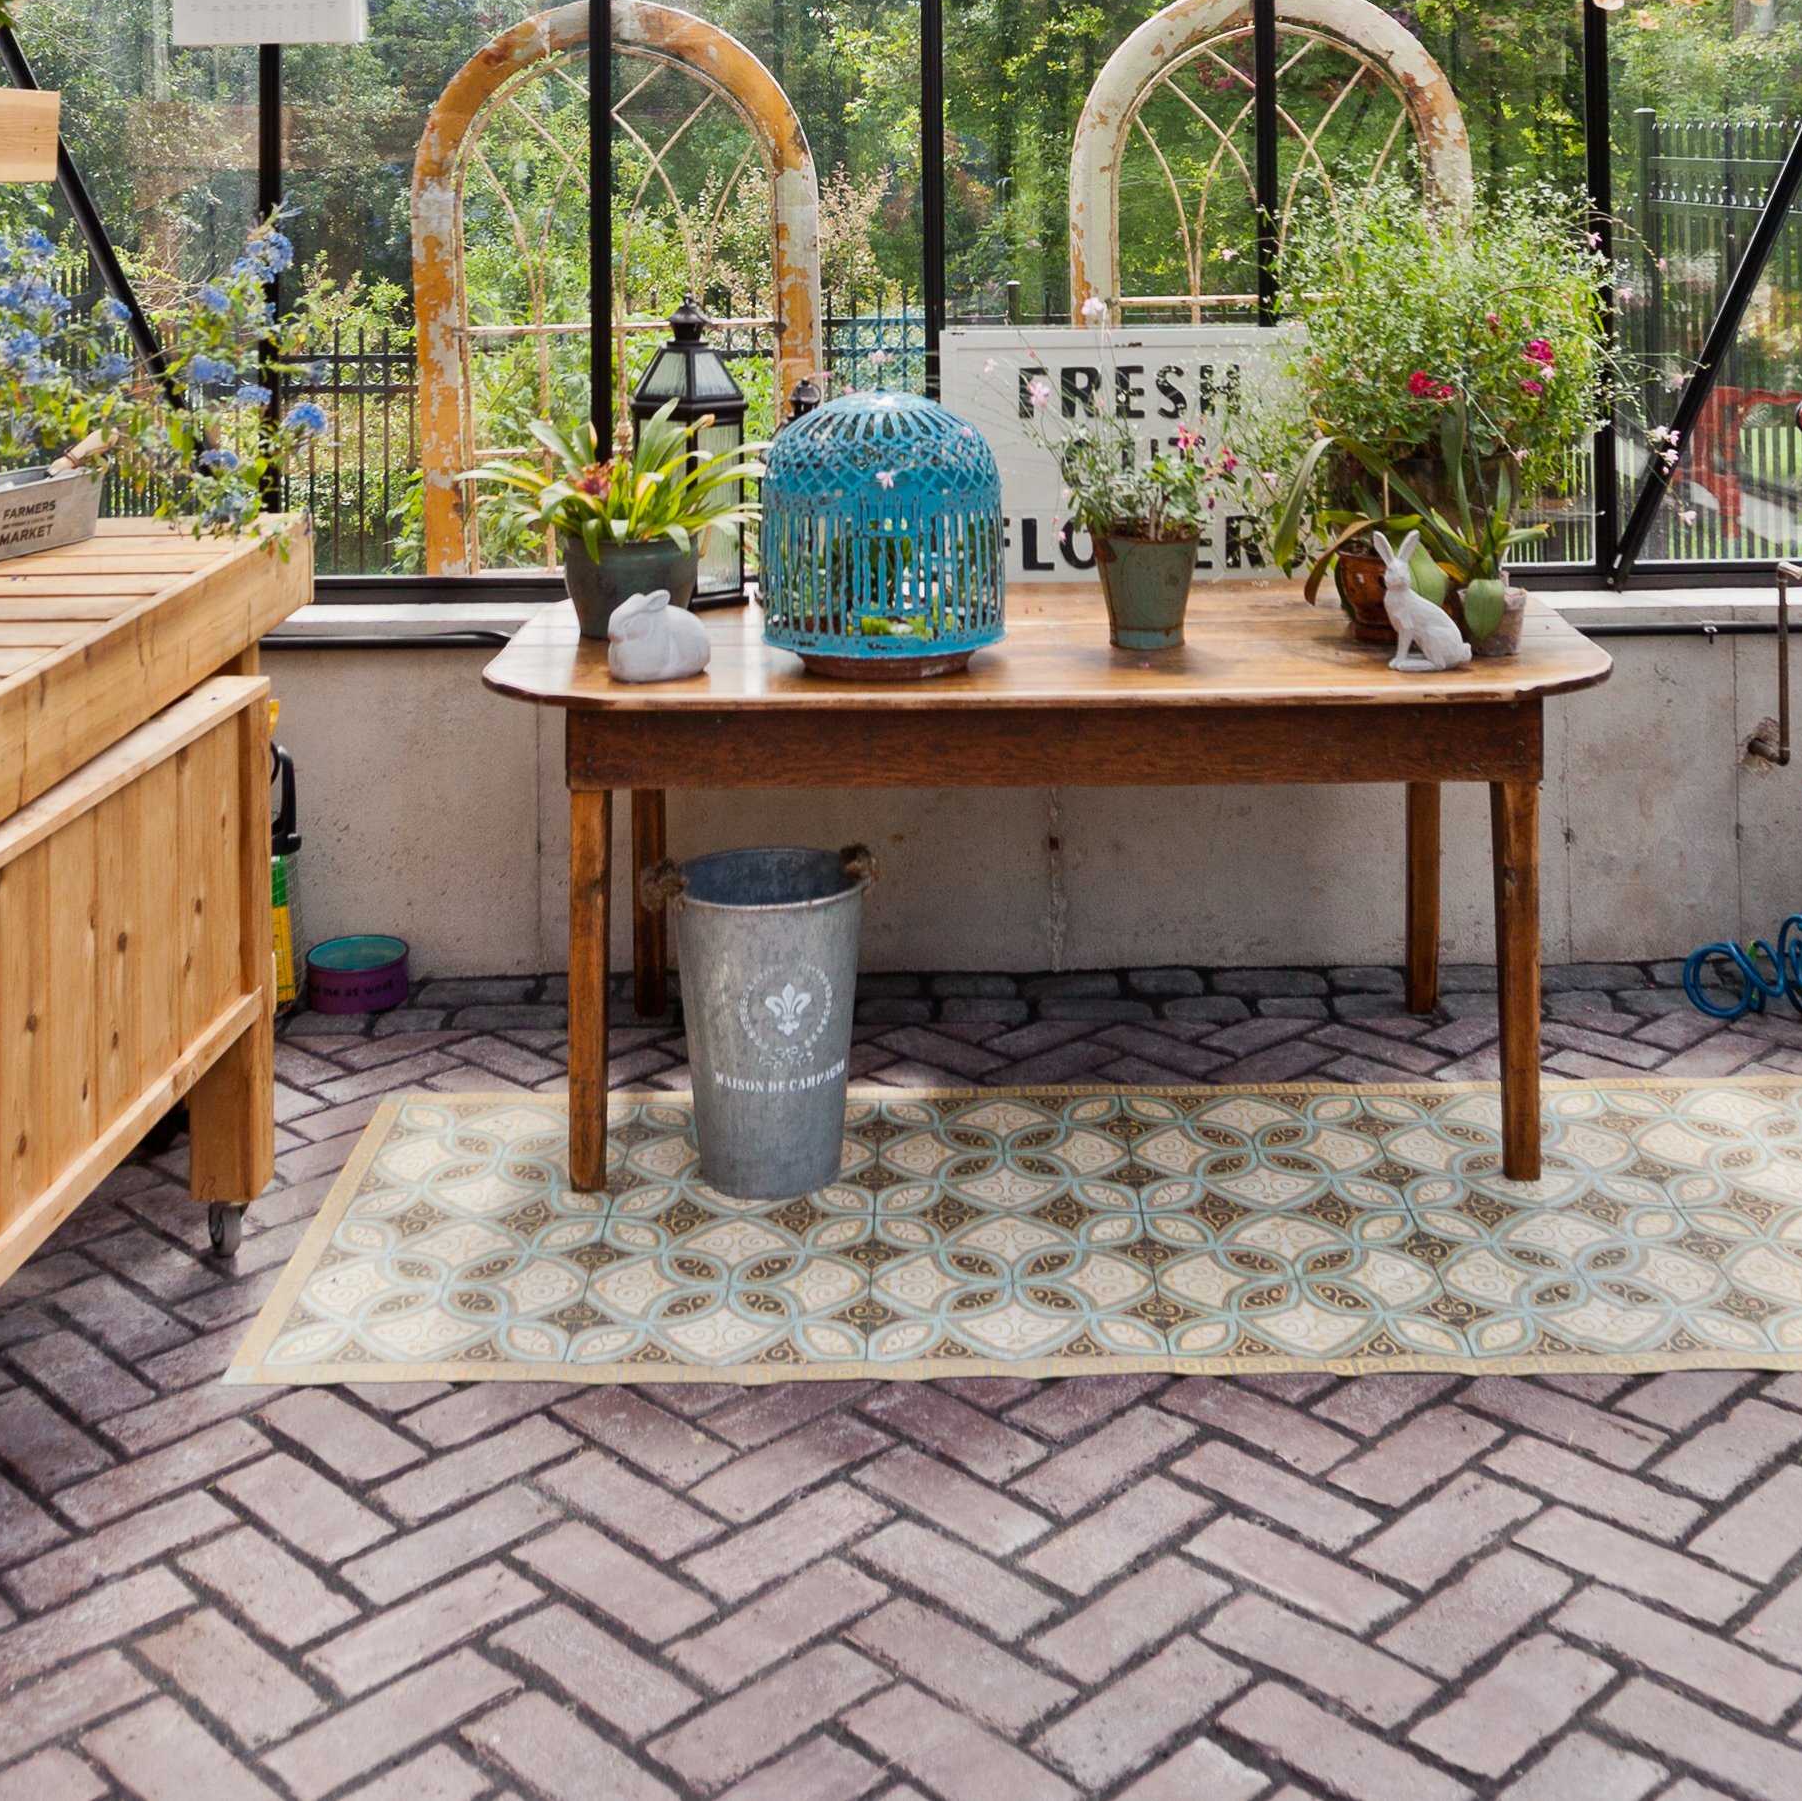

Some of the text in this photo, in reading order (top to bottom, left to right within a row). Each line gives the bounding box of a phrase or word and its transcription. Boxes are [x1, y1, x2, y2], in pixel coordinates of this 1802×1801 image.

[1018, 364, 1241, 419] FRESH
[2, 499, 57, 520] FARMERS
[715, 1071, 765, 1093] MAISON
[768, 1080, 787, 1093] DE
